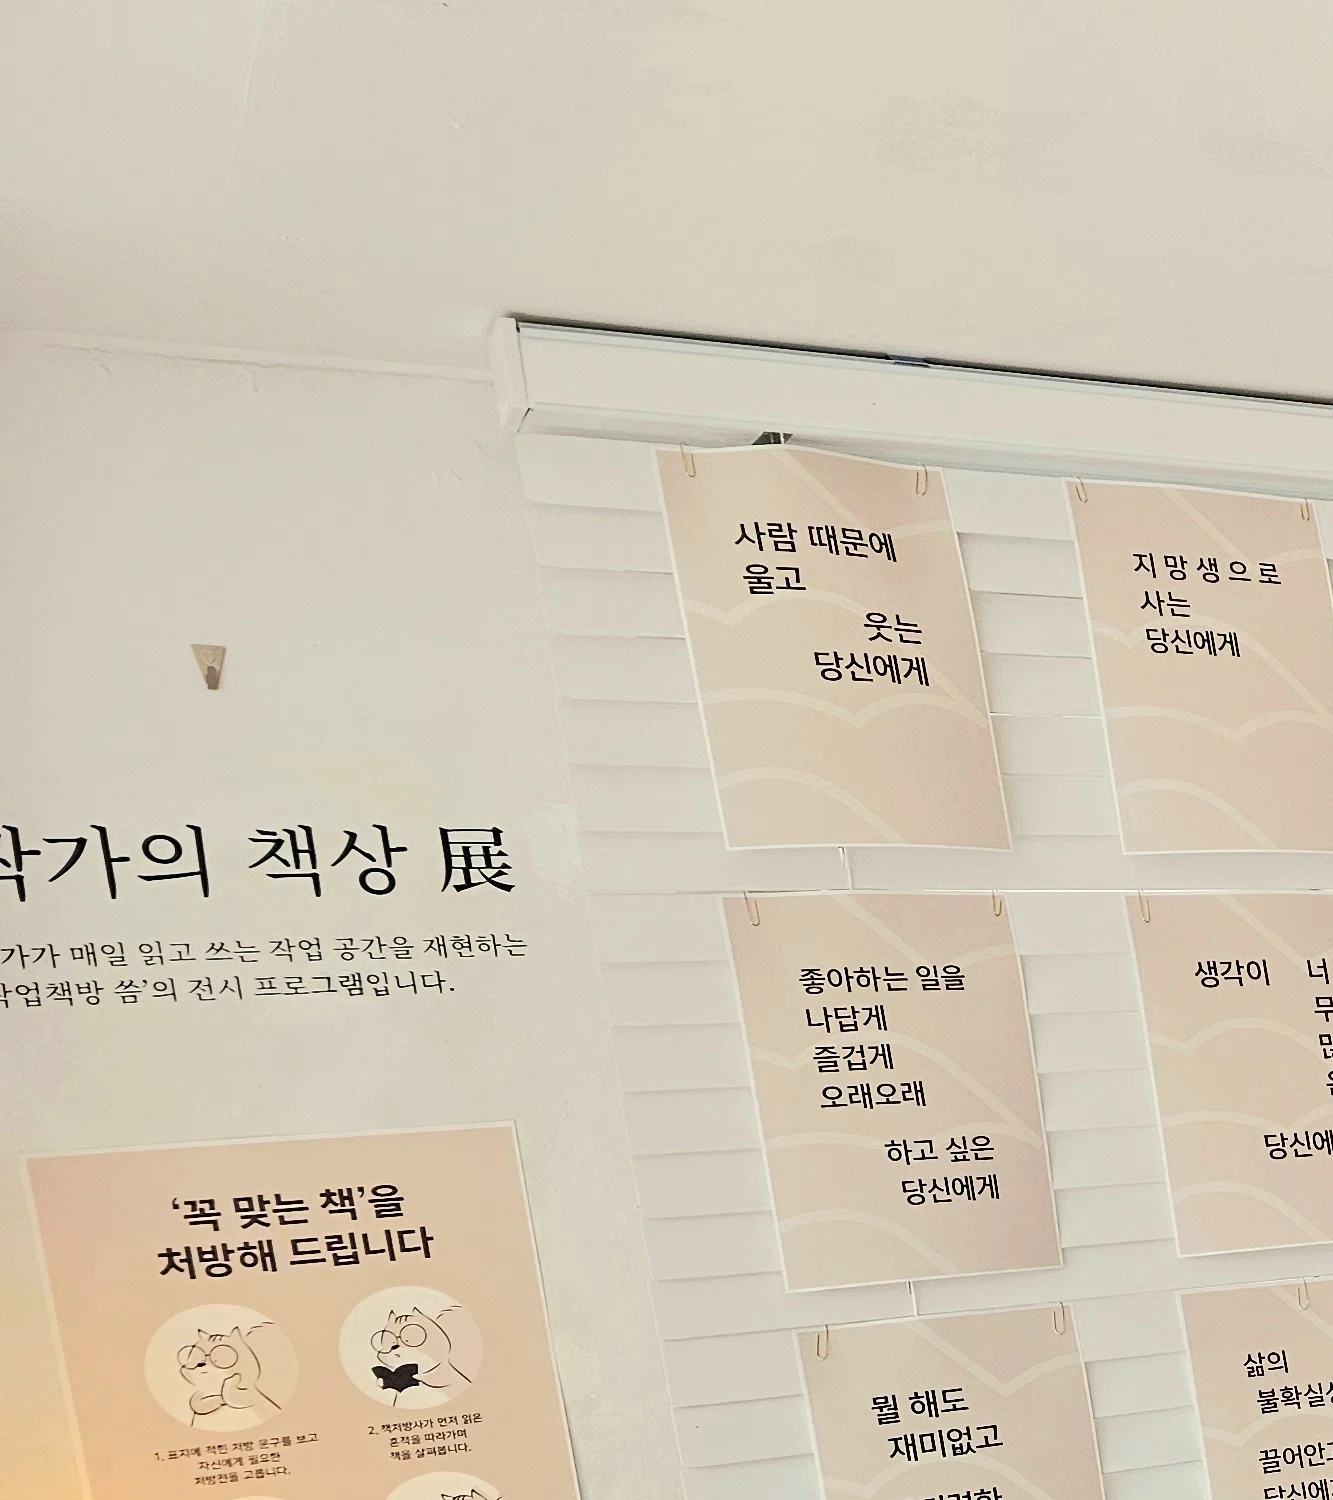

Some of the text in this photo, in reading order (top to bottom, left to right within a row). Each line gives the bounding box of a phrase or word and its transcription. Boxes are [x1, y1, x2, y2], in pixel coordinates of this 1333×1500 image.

[734, 521, 898, 563] 사람 때문에
[742, 563, 807, 595] 울고
[1140, 590, 1191, 618] 사는
[863, 612, 923, 645] 웃는
[1145, 627, 1241, 658] 당신에게
[813, 650, 930, 687] 당신에게
[247, 823, 408, 898] 책상
[438, 826, 516, 893] 展
[69, 941, 128, 968] 매일
[138, 940, 197, 966] 읽고
[205, 940, 261, 963] 쓰는
[269, 937, 323, 963] 작업
[333, 935, 415, 962] 공간을
[422, 933, 528, 959] 재현하는
[188, 975, 243, 1002] 전시
[254, 970, 455, 997] 프로그램입니다.
[798, 964, 966, 995] 좋아하는 일을
[1194, 958, 1271, 989] 생각이
[805, 1004, 888, 1034] 나답게
[812, 1043, 895, 1073] 즐겁게
[820, 1080, 927, 1110] 오래오래
[883, 1135, 995, 1166] 하고 싶은
[901, 1173, 1000, 1206] 당신에게
[232, 1193, 310, 1230] 맞는
[157, 1225, 435, 1280] 처방해 드립니다
[1243, 1349, 1289, 1378] 삶의
[870, 1387, 970, 1426] 뭘 해도
[883, 1419, 1004, 1462] 재미없고
